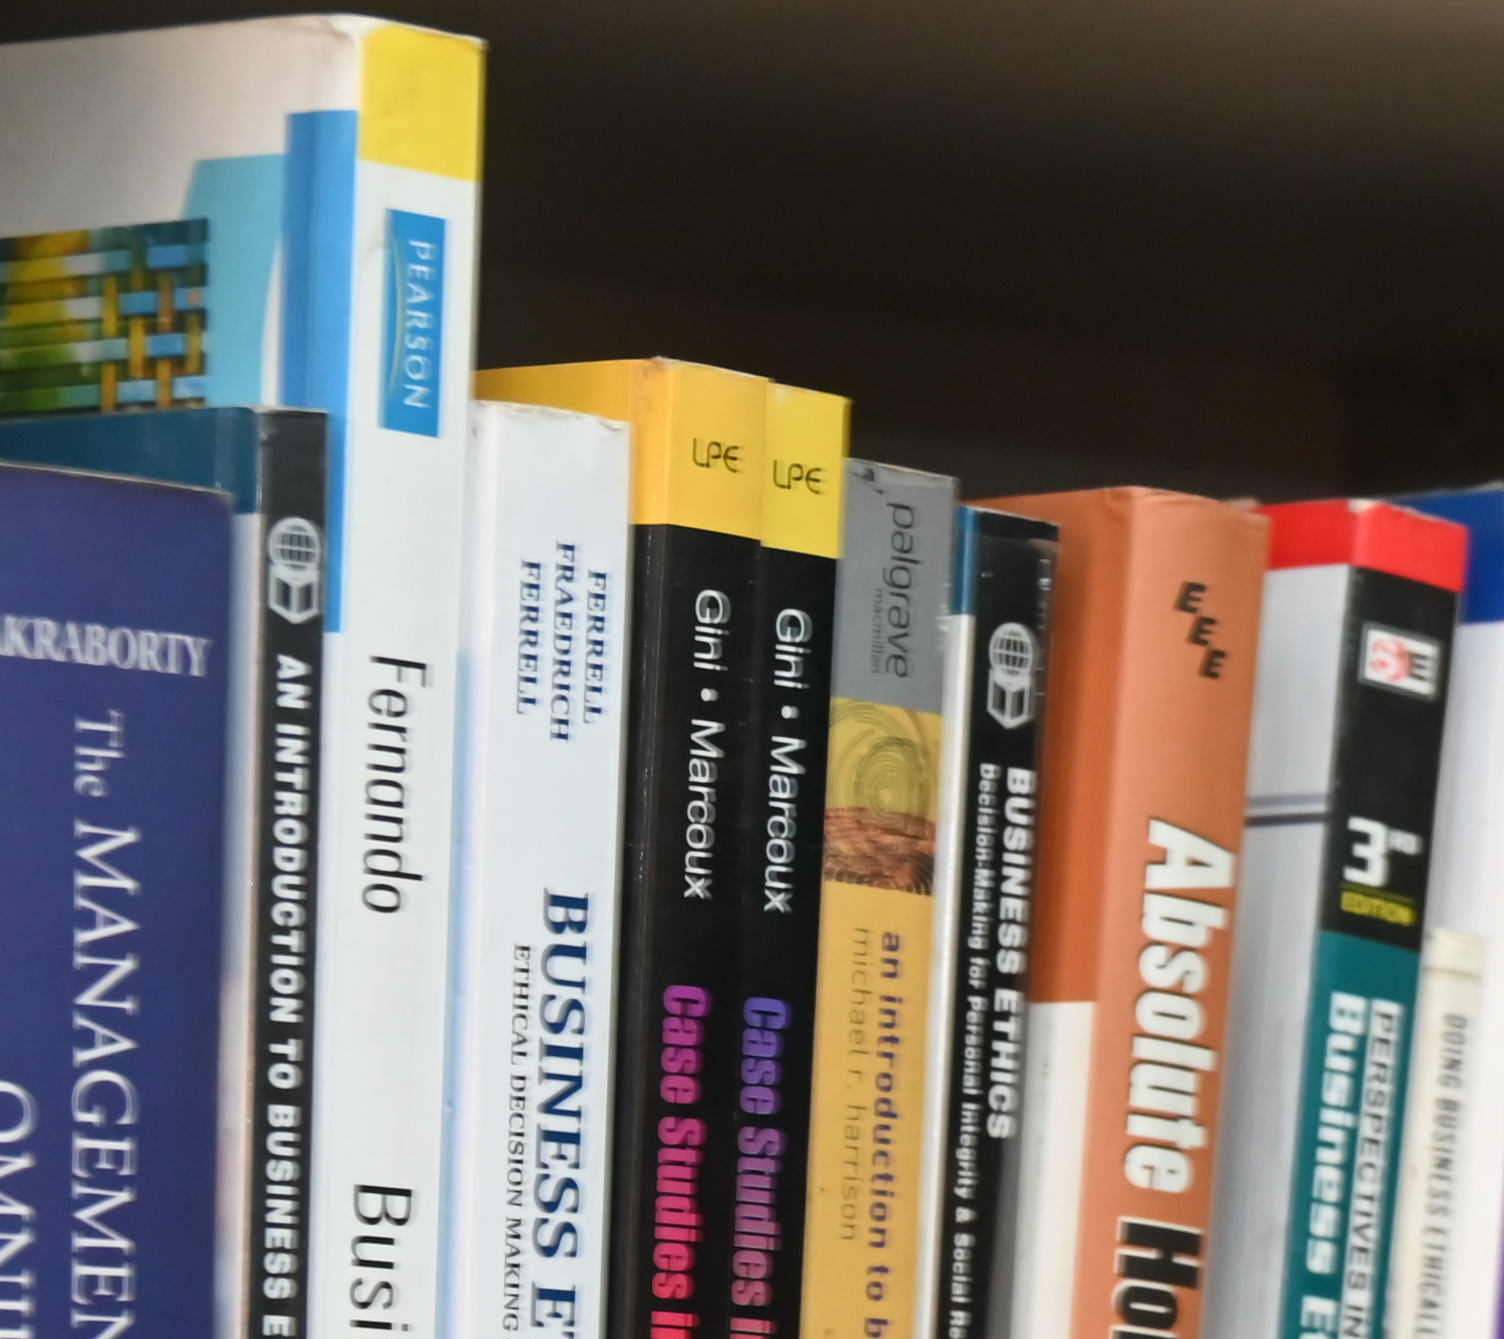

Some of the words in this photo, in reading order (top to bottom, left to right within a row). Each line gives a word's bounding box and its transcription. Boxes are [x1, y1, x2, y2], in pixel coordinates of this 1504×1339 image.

[401, 239, 438, 411] PEARSON
[692, 437, 742, 474] LPE
[772, 459, 826, 496] LPE
[515, 559, 541, 716] FERRELL
[549, 540, 576, 743] FRAEDRICH
[583, 568, 608, 724] FERRELL
[692, 587, 732, 672] Gini
[772, 606, 813, 692] Gini
[882, 500, 922, 680] palgrave
[74, 709, 127, 798] The
[275, 653, 312, 711] AN
[363, 652, 429, 917] Fernando
[683, 718, 727, 901] Marcoux
[763, 735, 808, 914] Marcoux
[267, 722, 312, 1023] INTRODUCTION
[995, 765, 1038, 976] BUSINESS
[510, 943, 534, 1067] ETHICAL
[848, 927, 875, 1056] michael
[880, 931, 901, 980] an
[1125, 817, 1236, 1196] Absolute
[266, 1038, 303, 1089] TO
[533, 886, 591, 1259] BUSINESS
[660, 984, 714, 1107] Case
[738, 996, 795, 1117] Case
[867, 994, 903, 1250] introduction
[986, 987, 1025, 1140] ETHICS
[1438, 1013, 1468, 1090] DOING
[261, 1102, 300, 1301] BUSINESS
[505, 1075, 525, 1207] DECISION
[651, 1115, 709, 1302] Studies
[840, 1104, 868, 1242] harrison
[1305, 992, 1368, 1276] Business
[1345, 1008, 1400, 1293] PERSPECTIVES
[1425, 1098, 1463, 1219] BUSINESS
[502, 1216, 522, 1332] MAKING
[731, 1124, 787, 1309] Studies
[864, 1264, 892, 1303] to
